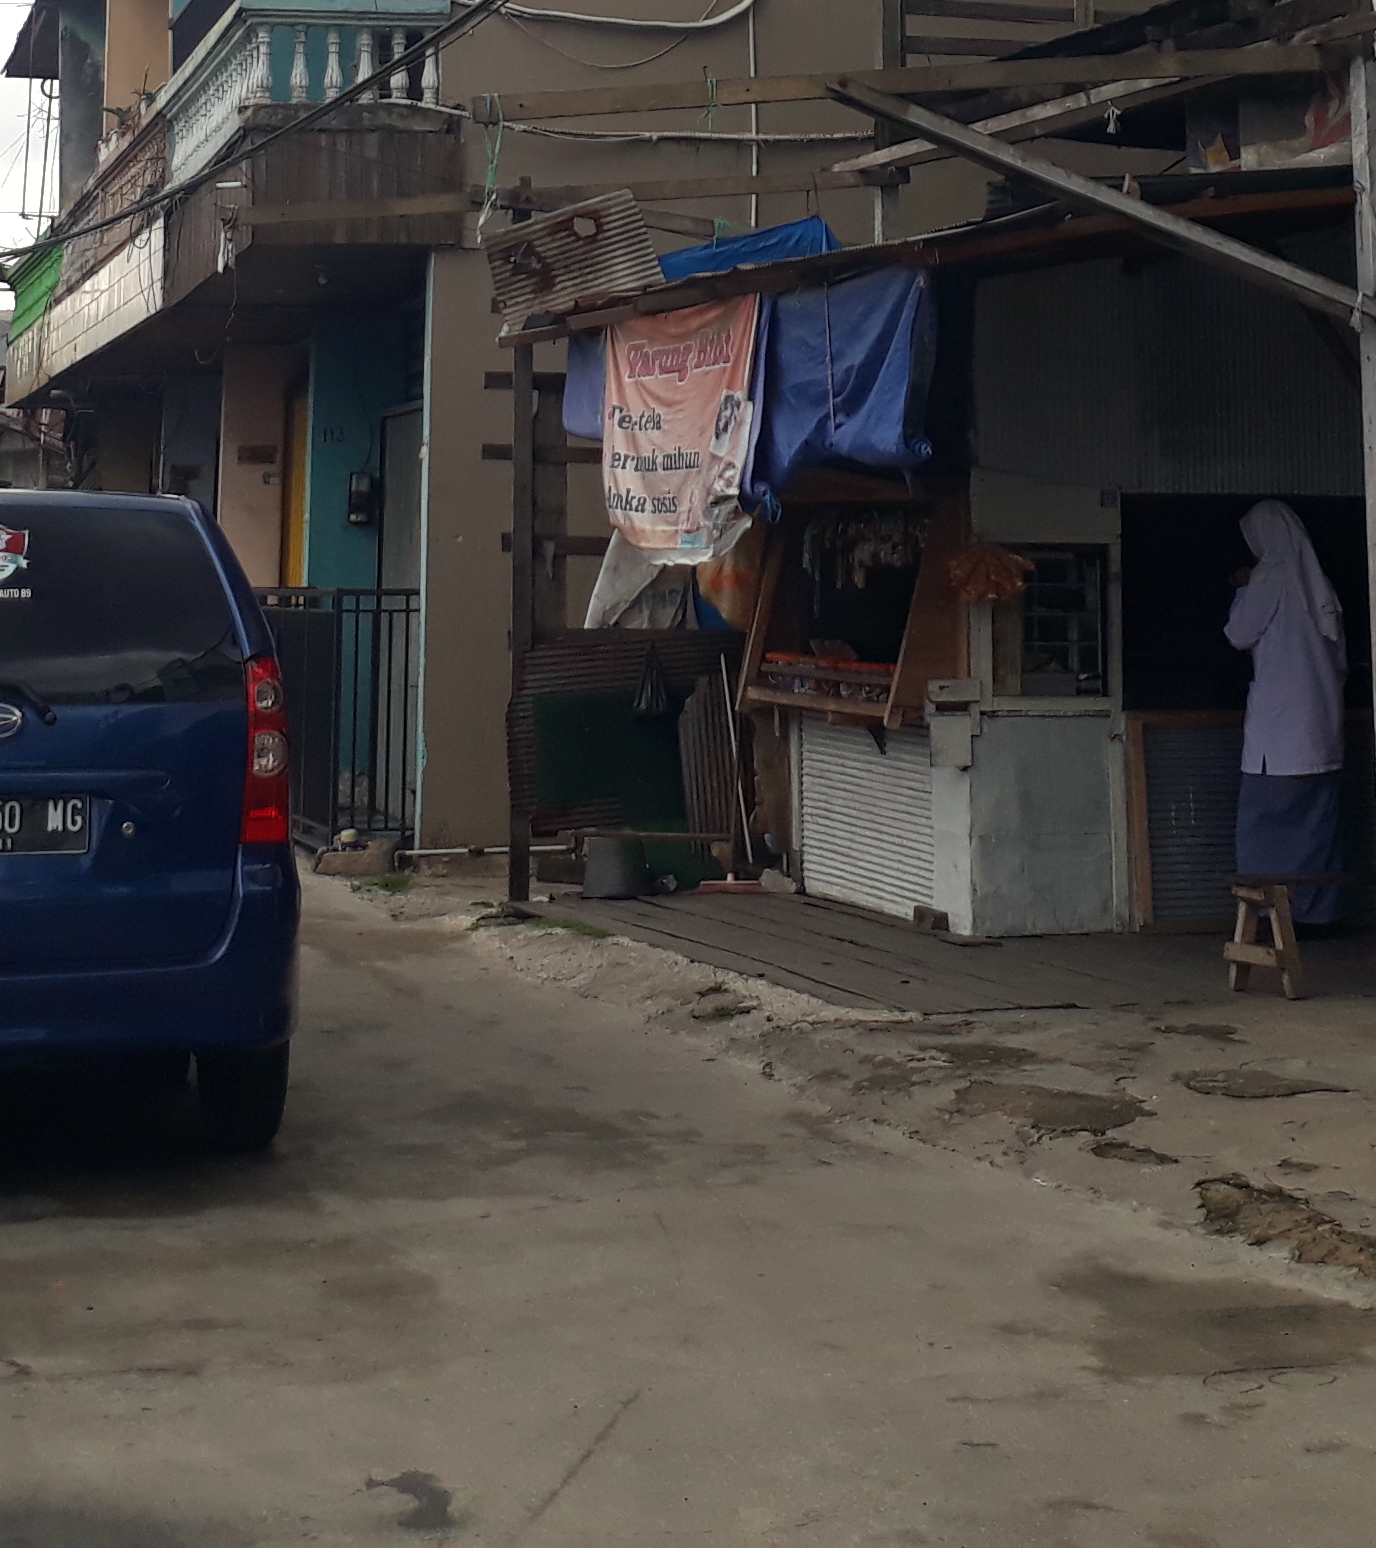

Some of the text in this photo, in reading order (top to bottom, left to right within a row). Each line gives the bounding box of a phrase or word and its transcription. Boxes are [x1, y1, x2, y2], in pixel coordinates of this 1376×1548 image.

[661, 446, 700, 471] mihun
[650, 489, 678, 515] sosis
[46, 799, 84, 832] MG
